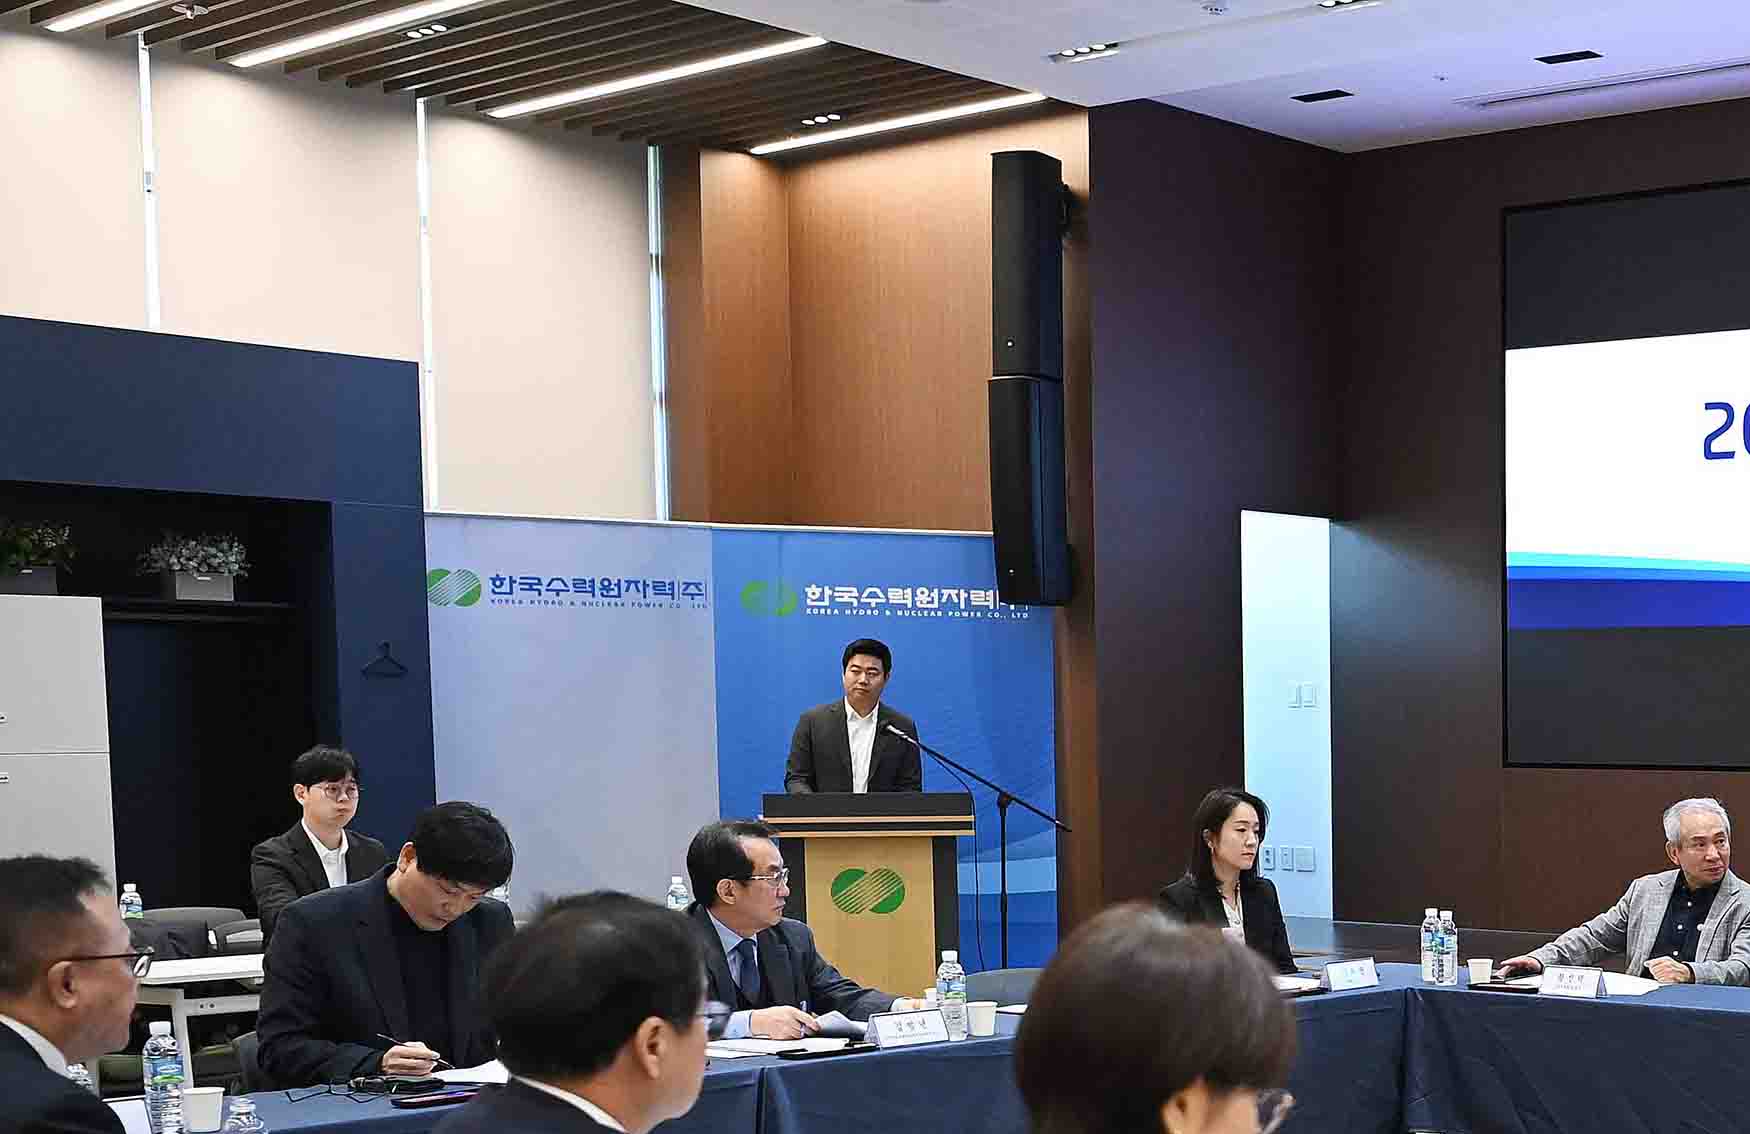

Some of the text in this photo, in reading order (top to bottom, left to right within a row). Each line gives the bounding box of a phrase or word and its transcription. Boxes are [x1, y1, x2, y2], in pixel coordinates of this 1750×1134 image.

[806, 608, 840, 616] KOREA
[845, 608, 880, 617] HYDRO
[897, 610, 943, 618] NUCLEAR
[948, 610, 983, 618] POWER
